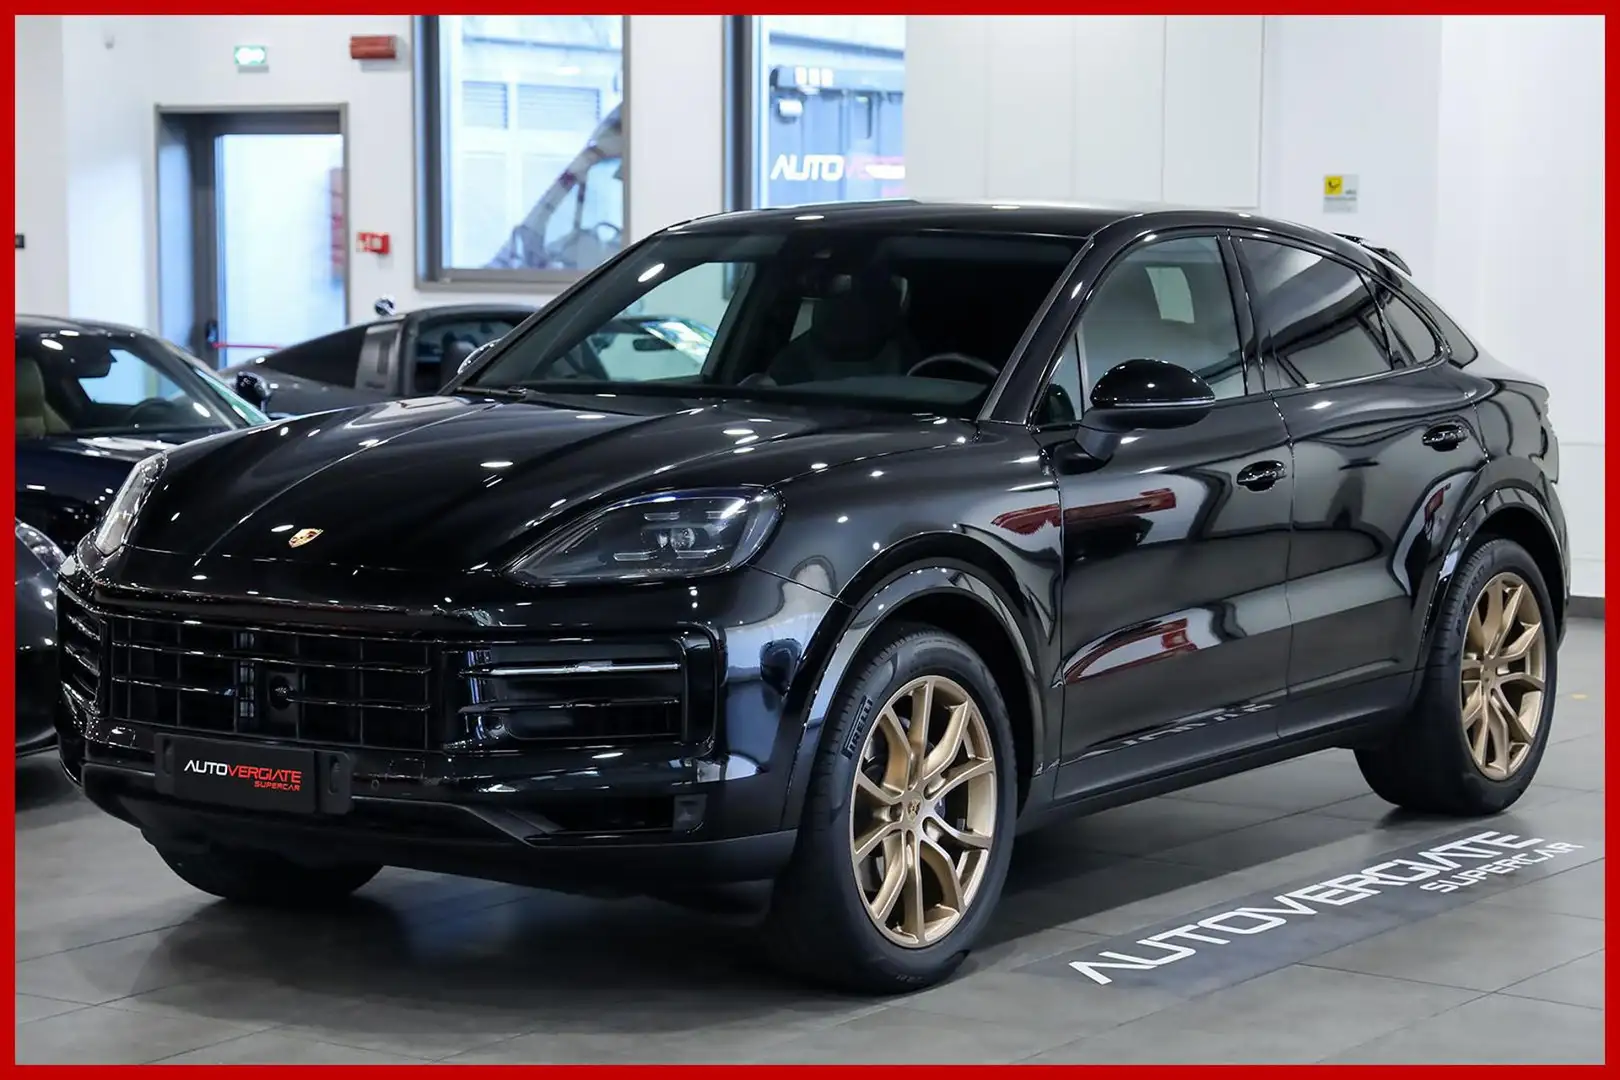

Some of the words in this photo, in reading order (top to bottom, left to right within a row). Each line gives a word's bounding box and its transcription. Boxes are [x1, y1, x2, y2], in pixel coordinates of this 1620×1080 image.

[842, 695, 874, 760] PIRELLI
[184, 759, 302, 783] AUTOVERGIATE
[254, 781, 301, 792] SUPERCAR
[1420, 843, 1584, 893] SUPERCAR
[1069, 831, 1544, 984] AUTOVERGIATE
